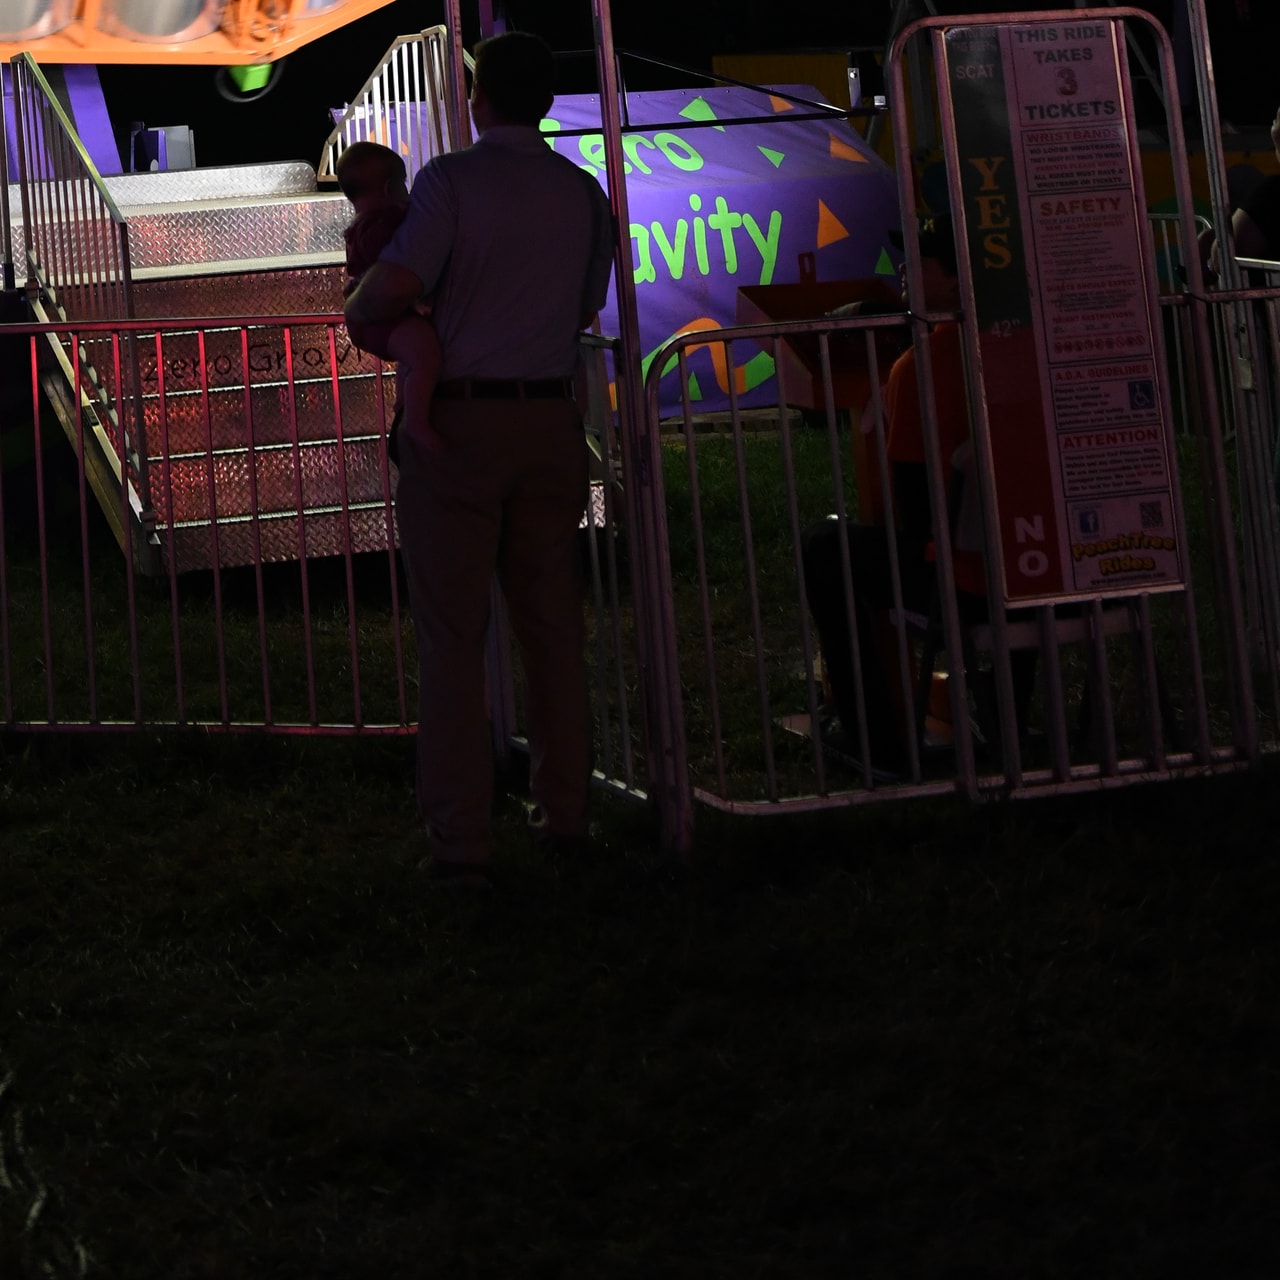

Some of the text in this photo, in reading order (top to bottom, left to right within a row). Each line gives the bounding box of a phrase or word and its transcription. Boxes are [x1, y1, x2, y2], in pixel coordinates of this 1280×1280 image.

[1014, 27, 1059, 44] THIS
[1064, 25, 1106, 40] RIDE
[1033, 47, 1094, 64] TAKES
[955, 63, 995, 80] SCAT
[1057, 67, 1079, 96] 3
[1024, 100, 1117, 121] TICKETS
[1026, 127, 1120, 143] WRISTBANDS
[968, 155, 1013, 269] YES
[1040, 197, 1121, 216] SAFETY
[144, 352, 233, 382] Zero
[1088, 364, 1149, 378] GUIDELINES
[1064, 428, 1158, 449] ATTENTION
[1014, 514, 1049, 577] NO
[1072, 531, 1177, 562] PeachTree
[1099, 554, 1156, 576] Rides
